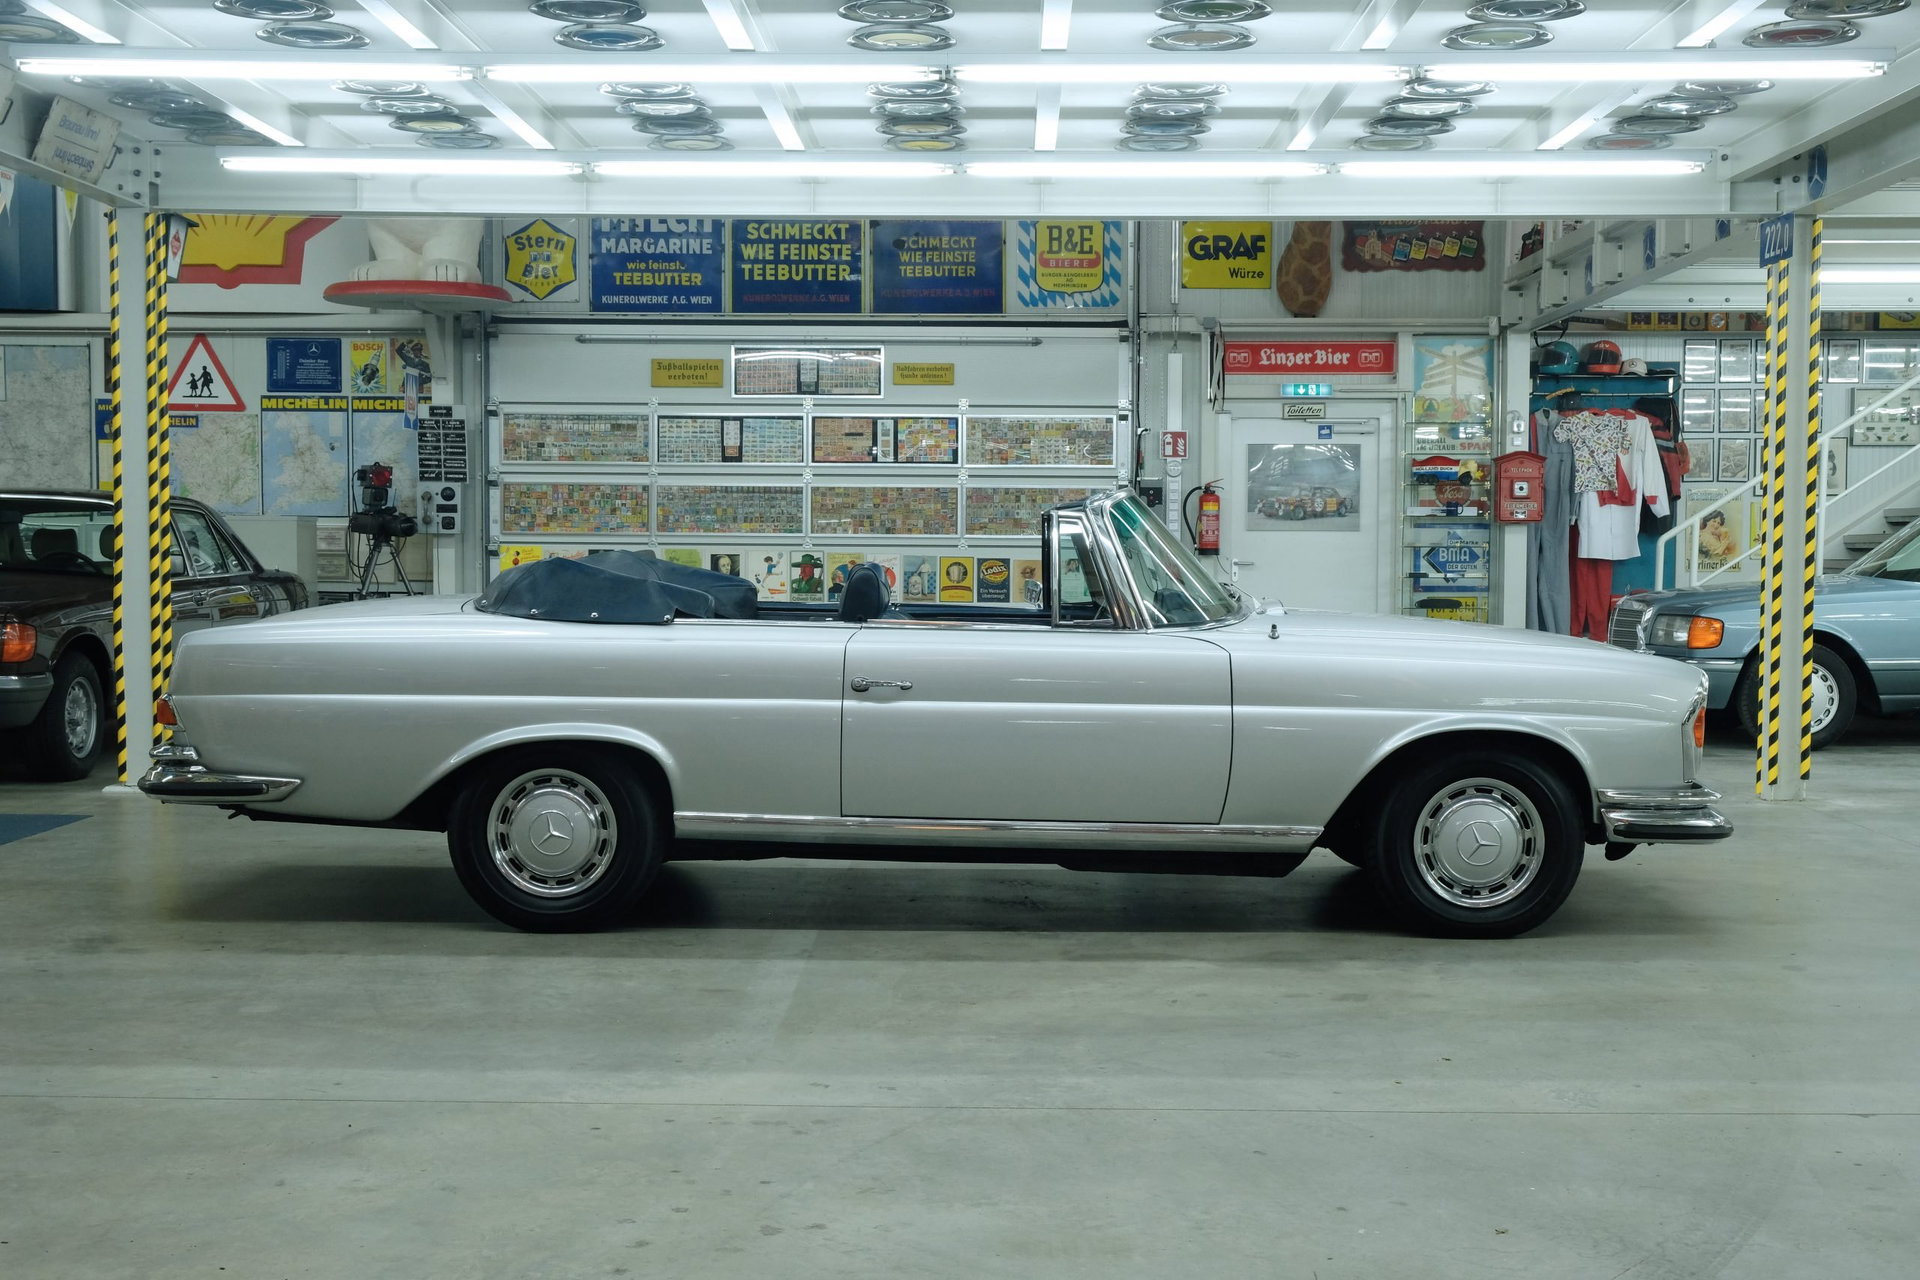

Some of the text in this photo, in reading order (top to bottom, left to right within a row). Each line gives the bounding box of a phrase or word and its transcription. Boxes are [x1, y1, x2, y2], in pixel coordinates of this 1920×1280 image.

[746, 223, 850, 240] SCHMECKT
[514, 234, 566, 252] Stern
[1046, 225, 1094, 254] B&E
[1187, 231, 1266, 261] GRAF
[1764, 222, 1790, 259] 222,0
[601, 238, 713, 255] MARGARINE
[740, 243, 852, 260] WIE FEINSTE
[899, 251, 977, 263] WIE FEINSTE
[1049, 259, 1089, 268] BIERE
[521, 263, 559, 280] Bier
[626, 260, 647, 270] wie
[899, 265, 977, 277] TEEBUTTER
[613, 272, 703, 286] TEEBUTTER
[741, 264, 852, 281] TEEBUTTER
[1228, 266, 1265, 279] Würze
[601, 295, 713, 305] KUNEROLWERKE A.G. WIEN
[828, 293, 851, 303] WIEN
[352, 342, 384, 352] BOSCH
[1258, 347, 1351, 368] Linzer Bier
[656, 361, 720, 372] Fußballspielen
[667, 372, 708, 381] verboten!
[261, 397, 348, 410] MICHELIN
[1286, 405, 1323, 415] Toiletten
[1439, 547, 1470, 562] BMA
[981, 564, 1008, 576] Lodix
